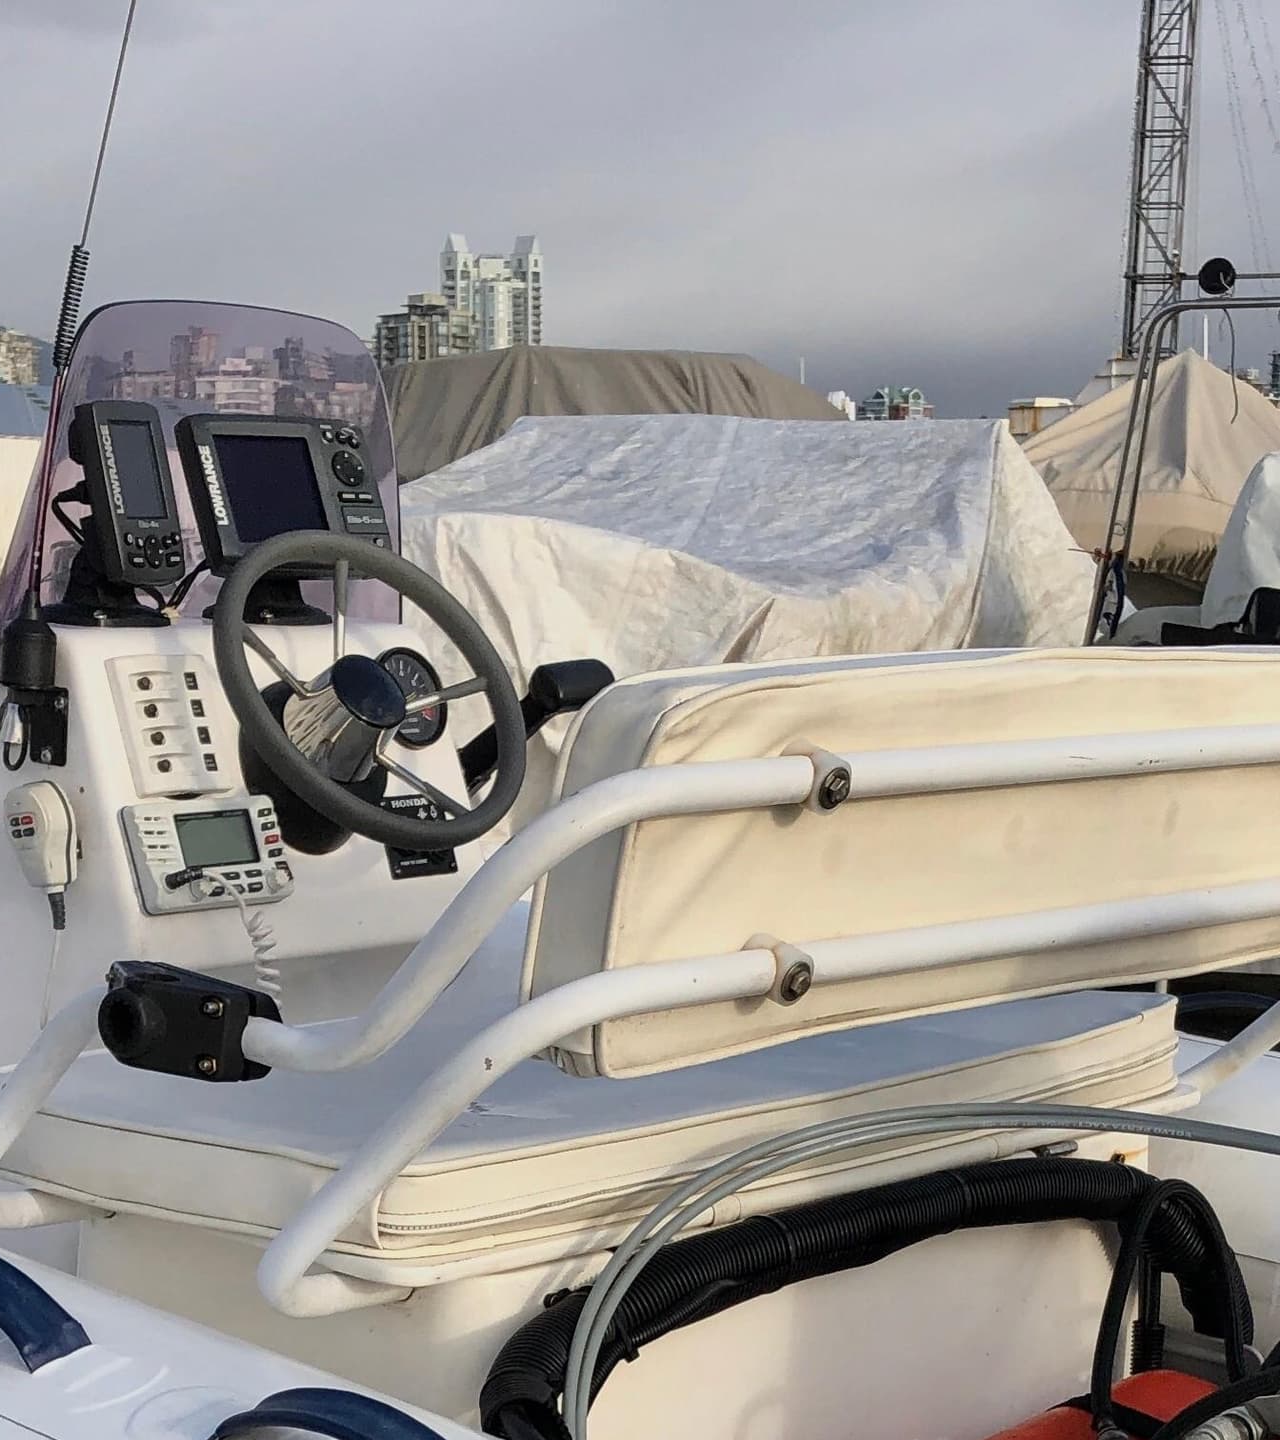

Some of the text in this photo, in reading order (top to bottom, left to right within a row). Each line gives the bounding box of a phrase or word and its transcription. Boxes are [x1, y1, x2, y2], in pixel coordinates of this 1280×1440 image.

[99, 424, 125, 514] LOWRANCE
[198, 445, 230, 526] LOWRANCE
[391, 797, 429, 809] HONDA
